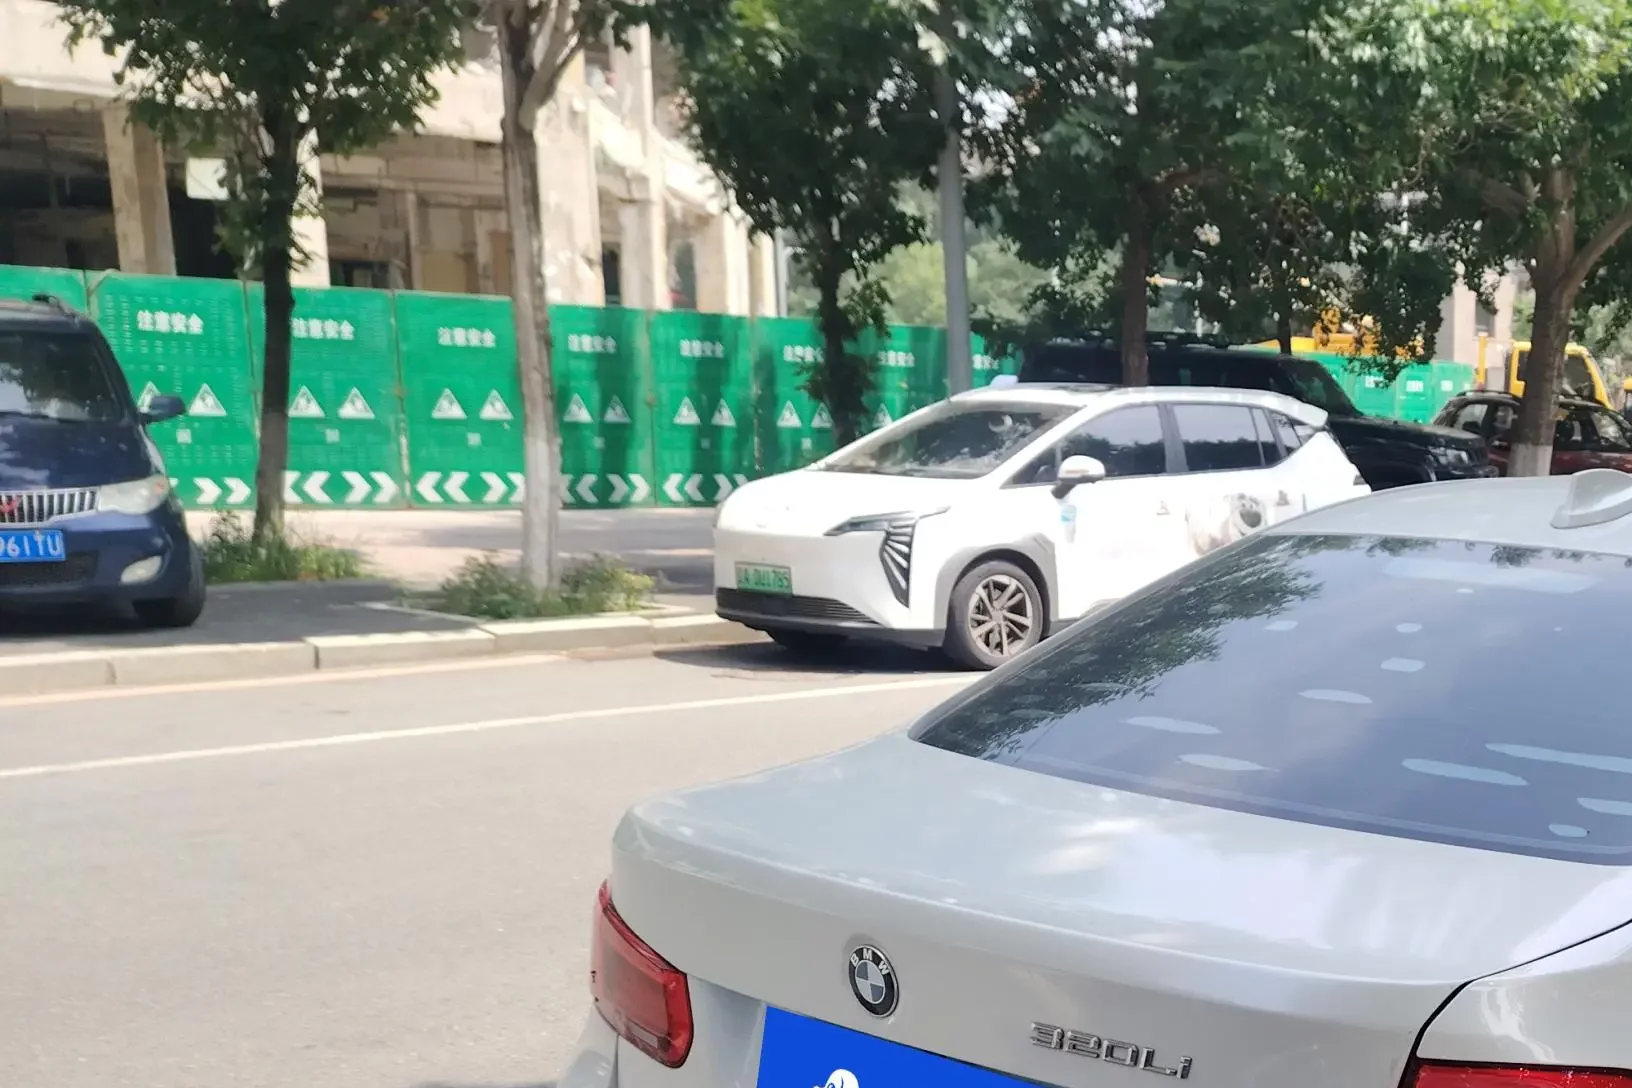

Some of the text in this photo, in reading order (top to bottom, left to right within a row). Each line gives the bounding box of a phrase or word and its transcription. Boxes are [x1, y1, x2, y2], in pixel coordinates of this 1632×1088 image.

[137, 309, 204, 335] 注意安全
[292, 318, 355, 340] 注意安全
[437, 327, 496, 348] 注意安全
[850, 948, 890, 975] BMW
[1030, 1022, 1192, 1080] 320Li
